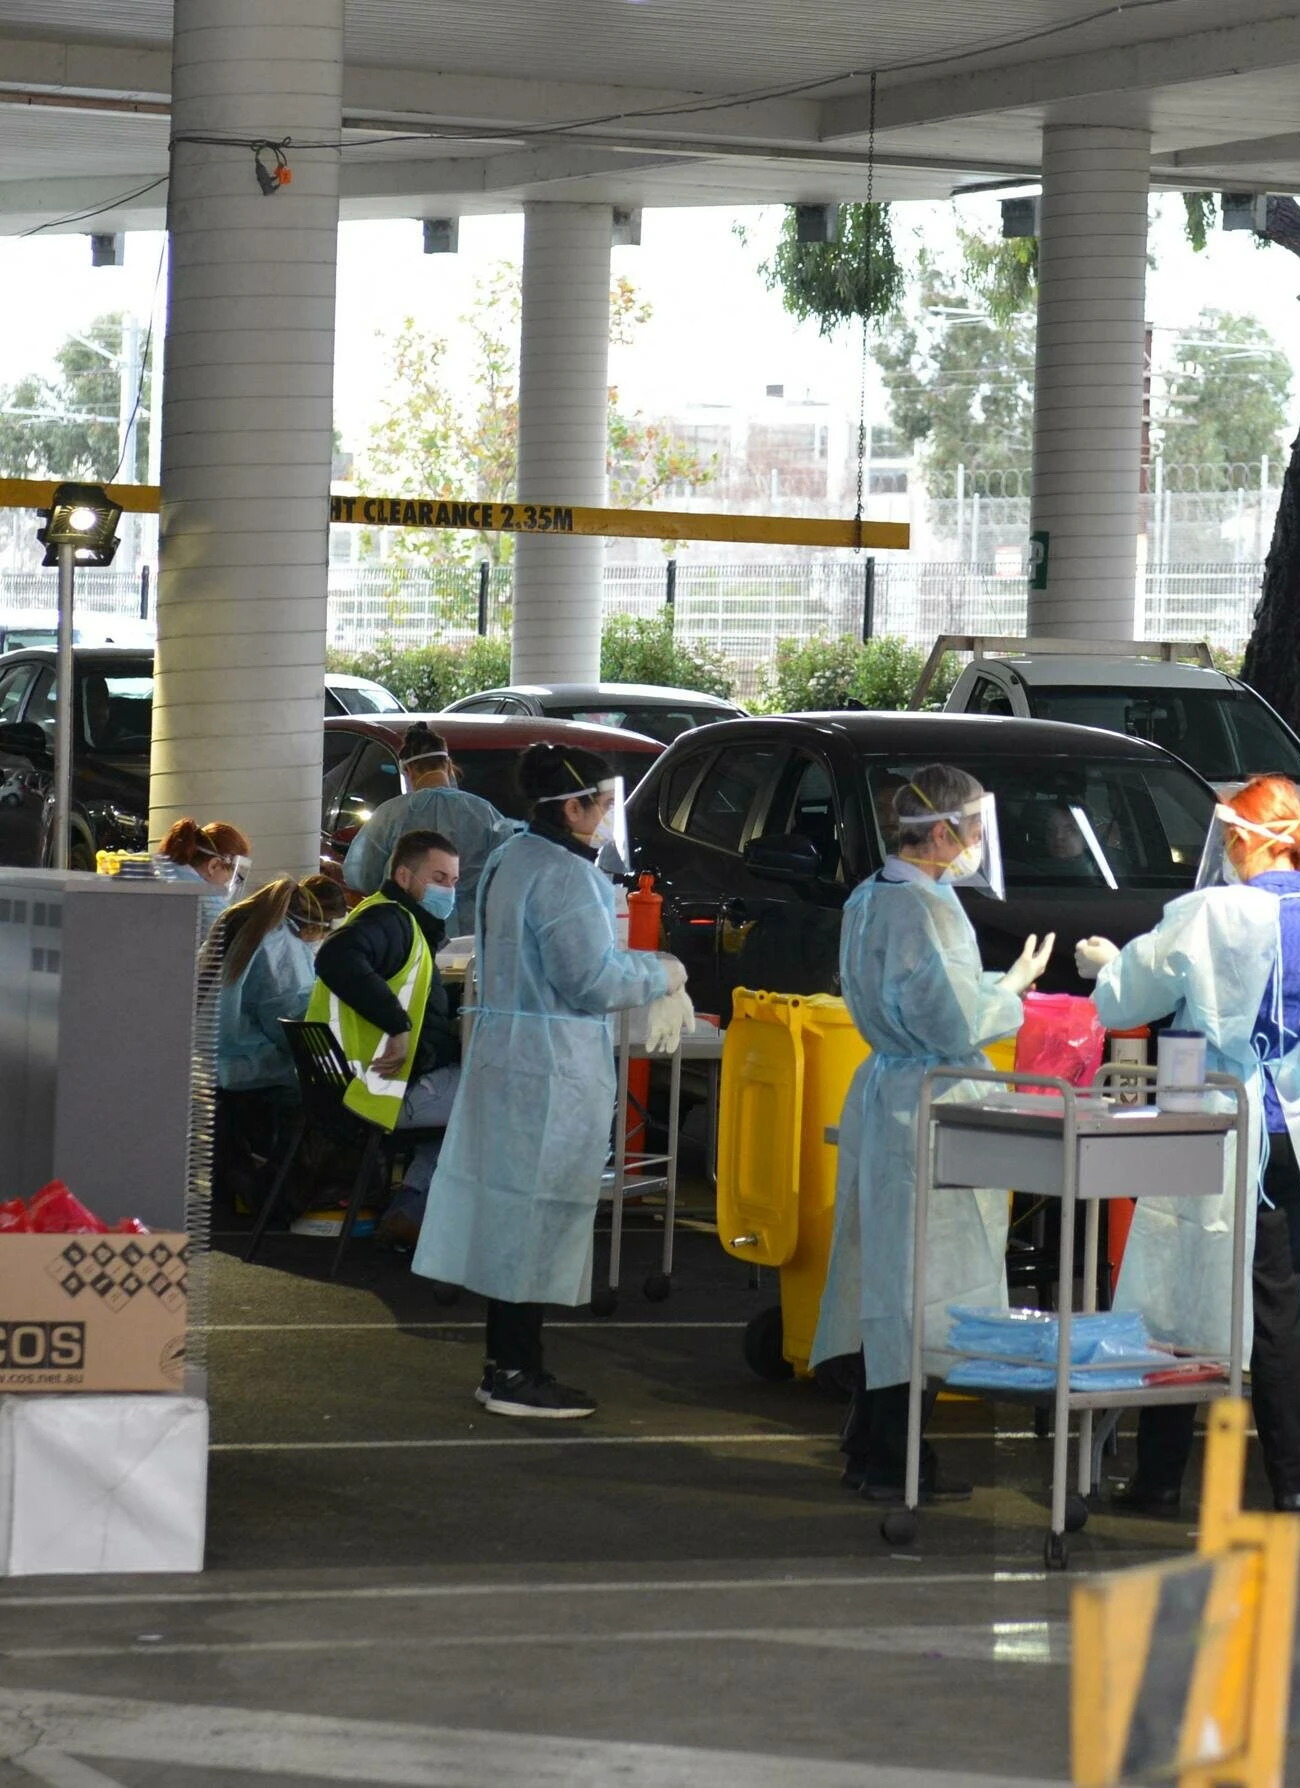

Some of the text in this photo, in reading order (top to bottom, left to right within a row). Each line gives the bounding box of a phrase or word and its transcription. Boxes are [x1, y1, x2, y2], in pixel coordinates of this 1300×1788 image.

[364, 500, 493, 529] CLEARANCE
[501, 505, 573, 532] 2.35M
[0, 1326, 81, 1364] OS
